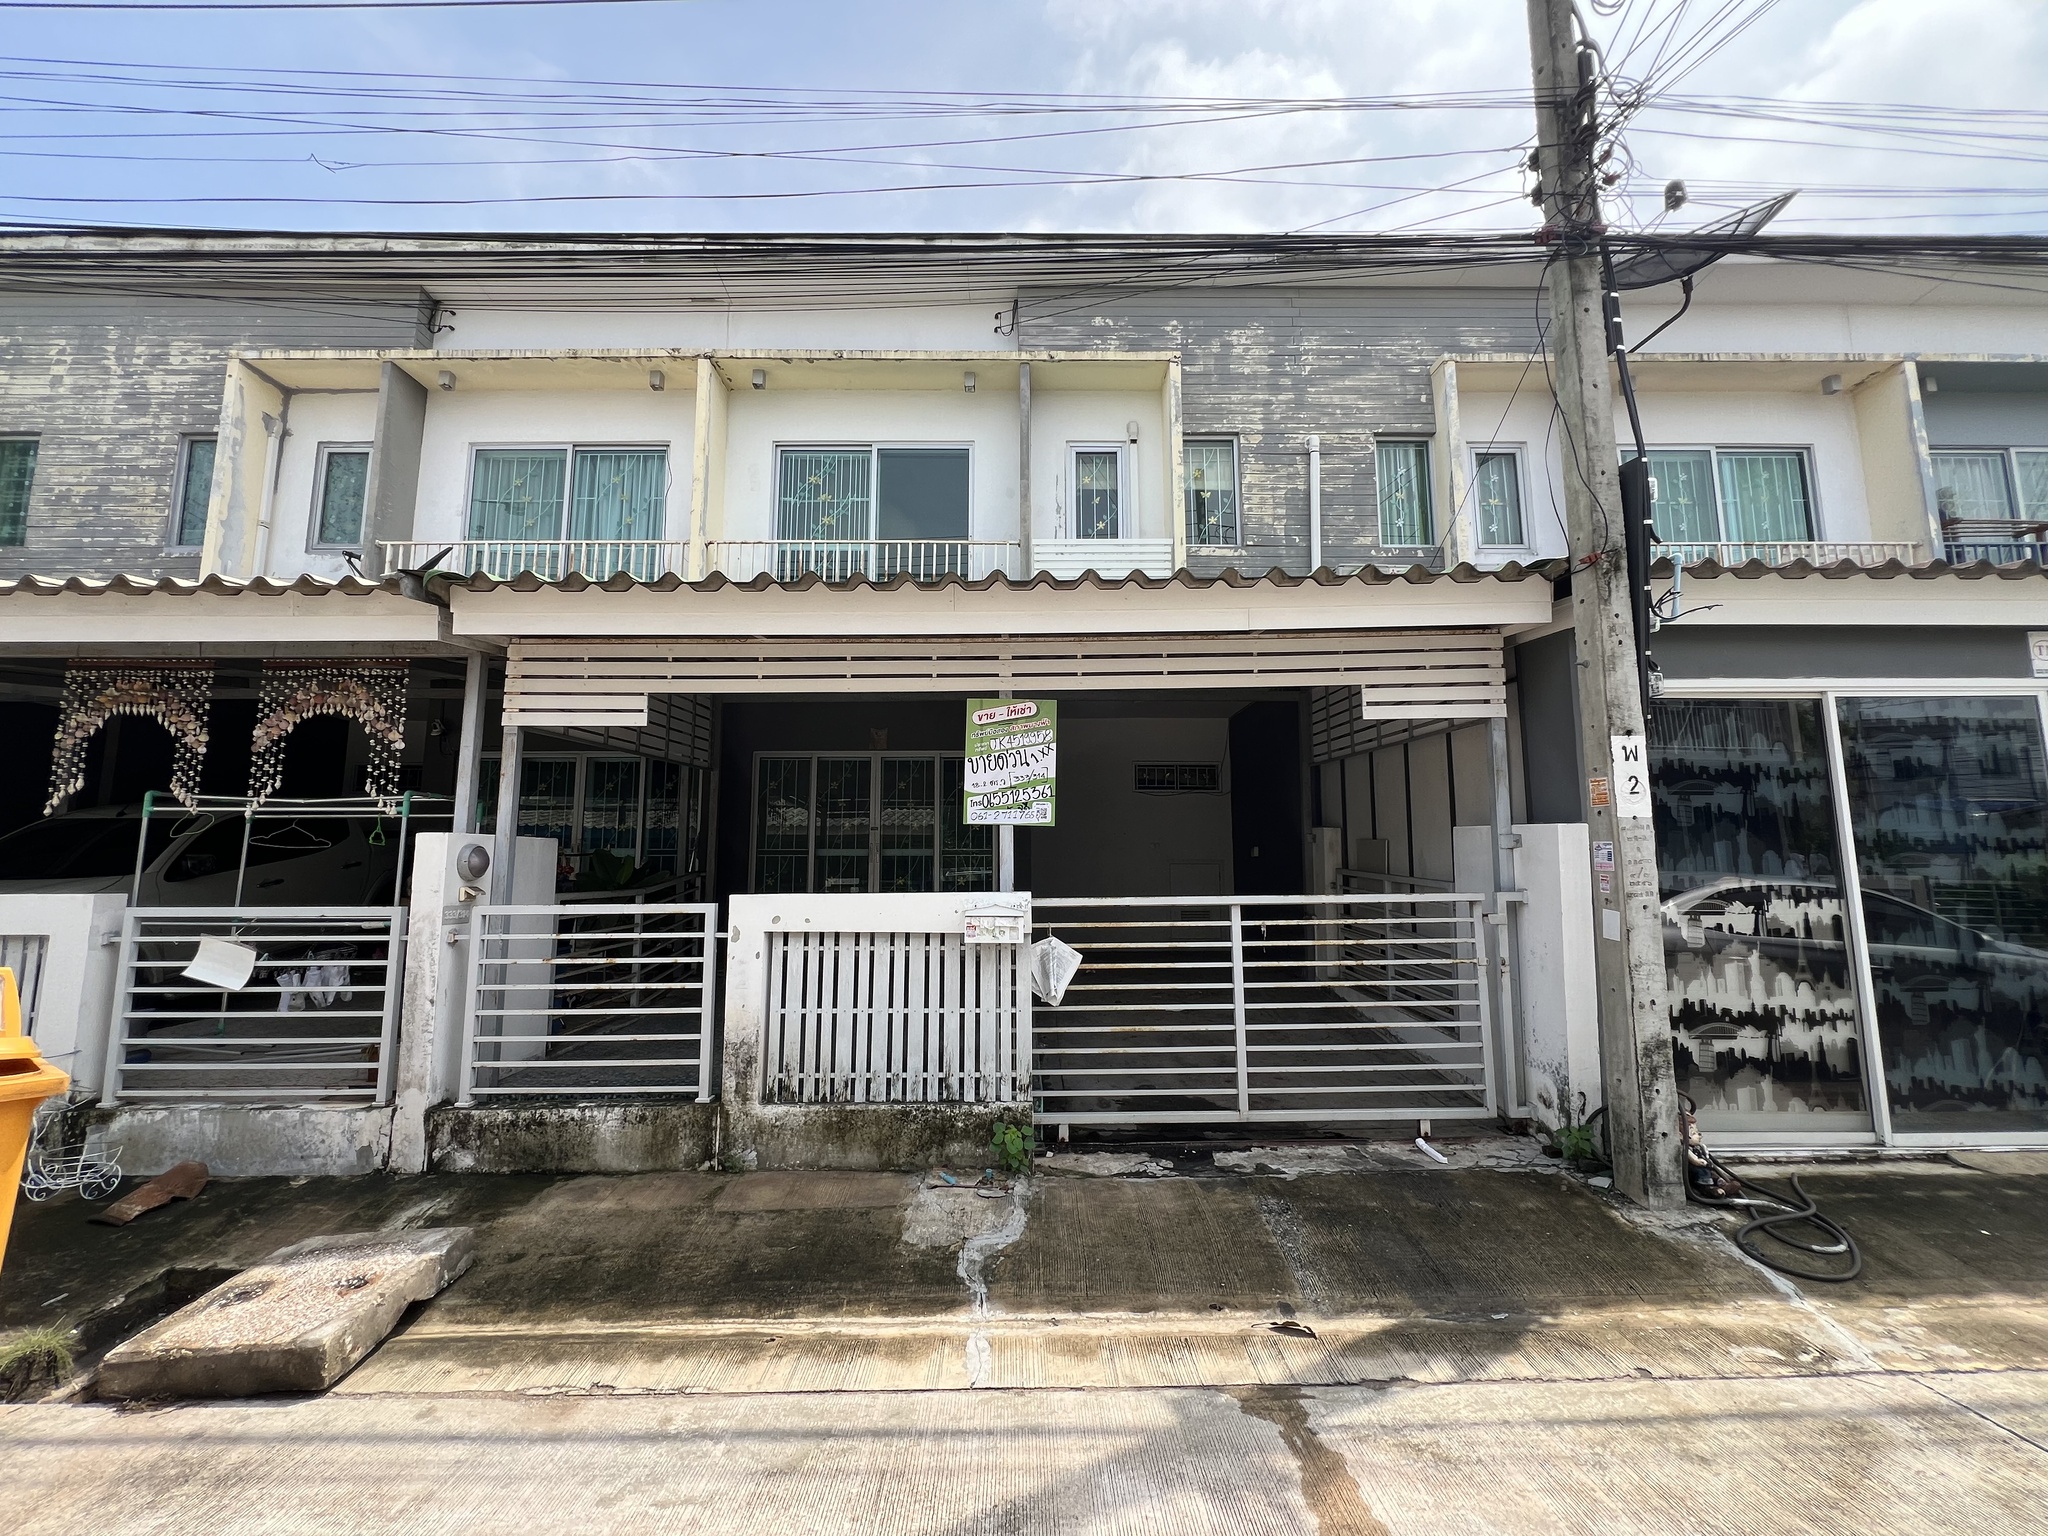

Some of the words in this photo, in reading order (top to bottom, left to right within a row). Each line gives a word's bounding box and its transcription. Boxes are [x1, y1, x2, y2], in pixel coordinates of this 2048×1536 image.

[977, 712, 996, 722] ขาย
[1006, 704, 1032, 717] ให้เช่า
[967, 749, 1030, 774] ขายด่วน
[1628, 775, 1640, 795] 2
